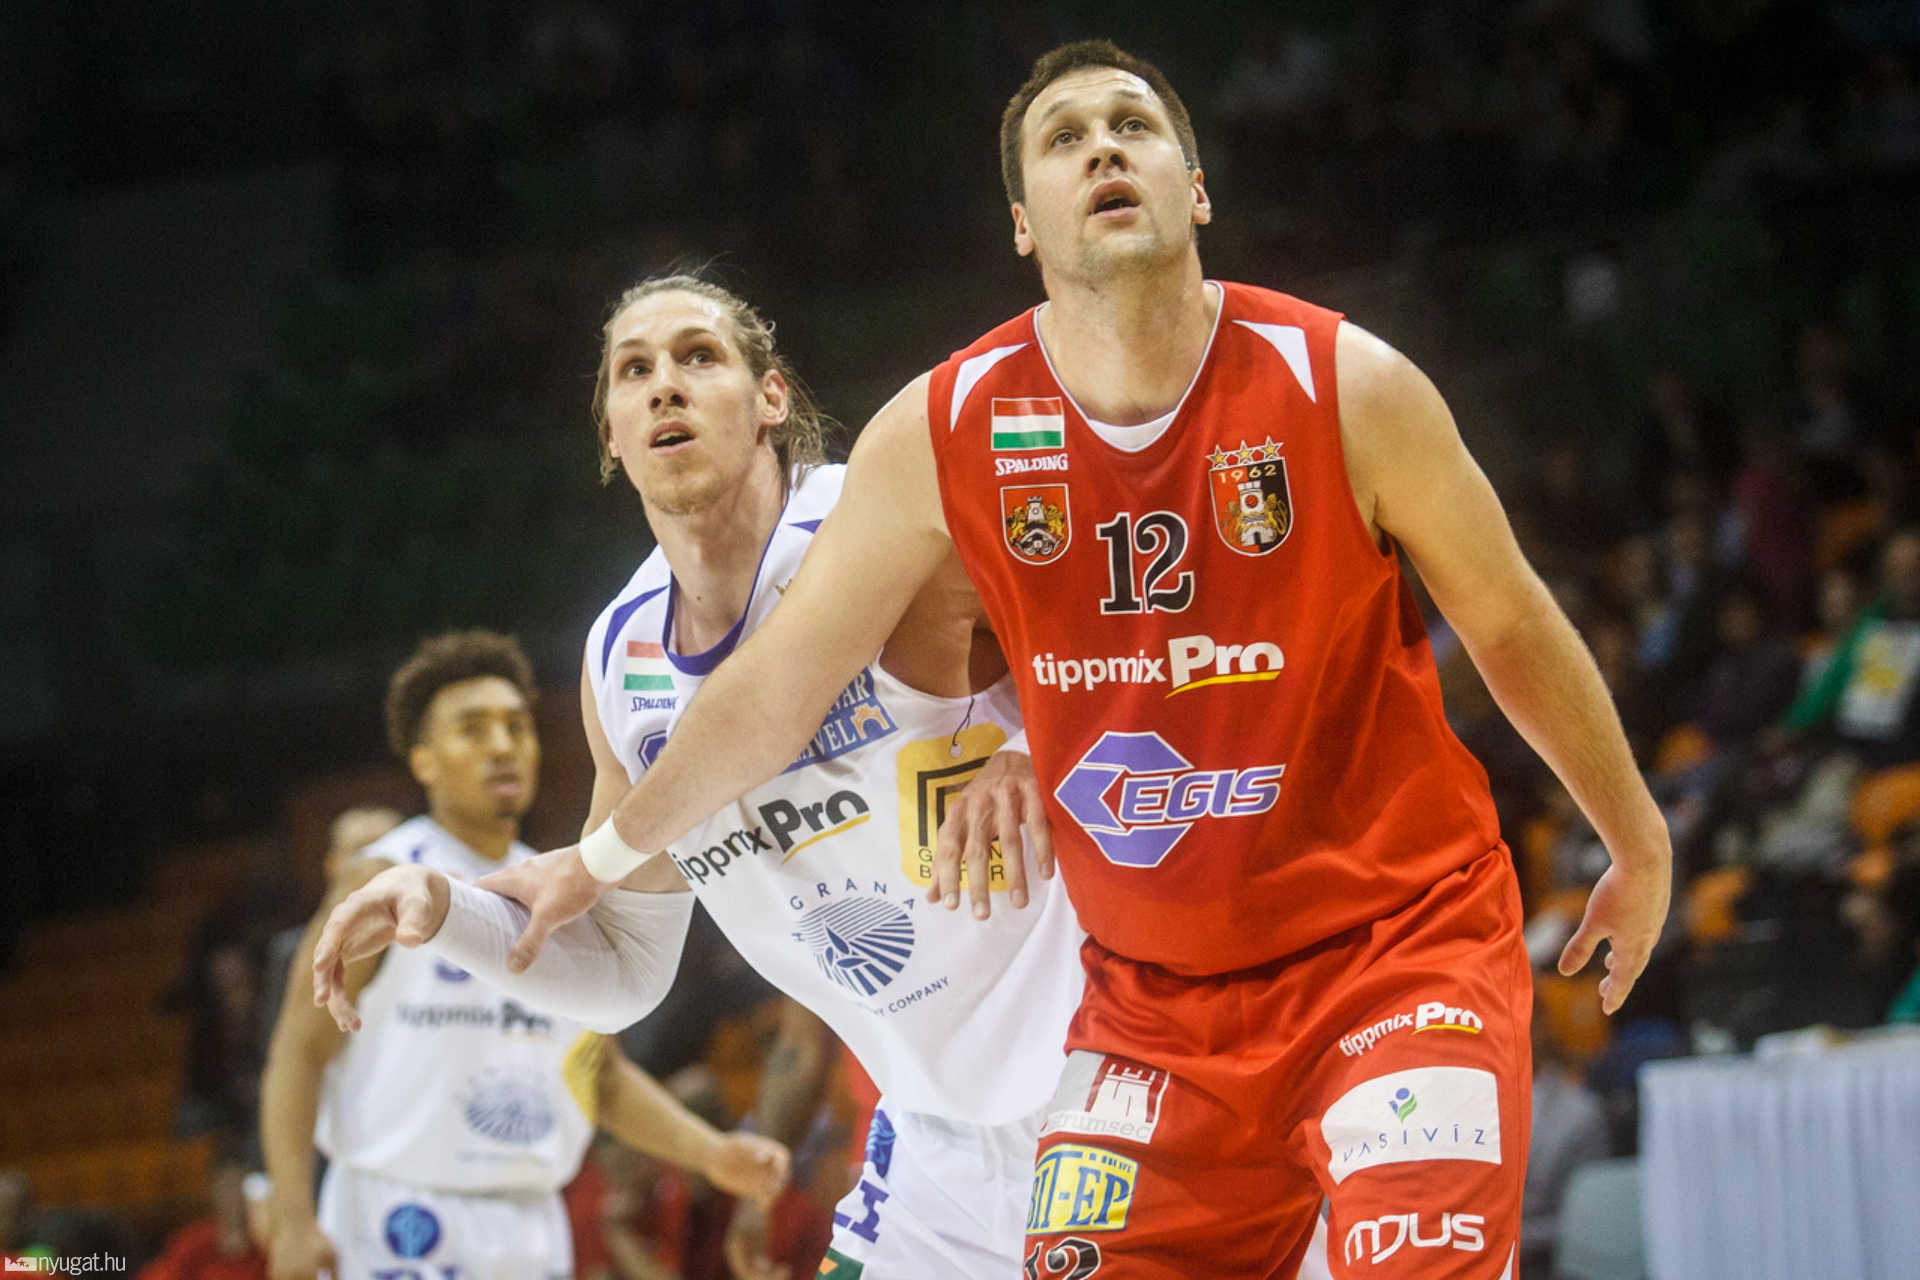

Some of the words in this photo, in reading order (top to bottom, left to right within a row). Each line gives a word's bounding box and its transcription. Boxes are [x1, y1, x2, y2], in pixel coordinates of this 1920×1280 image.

[994, 453, 1069, 476] SPALDING
[1218, 464, 1278, 484] 1962
[1095, 510, 1195, 615] 12
[1118, 764, 1287, 824] EGIS
[887, 976, 950, 1014] COMPANY
[1343, 1124, 1486, 1163] VASIVÍZ
